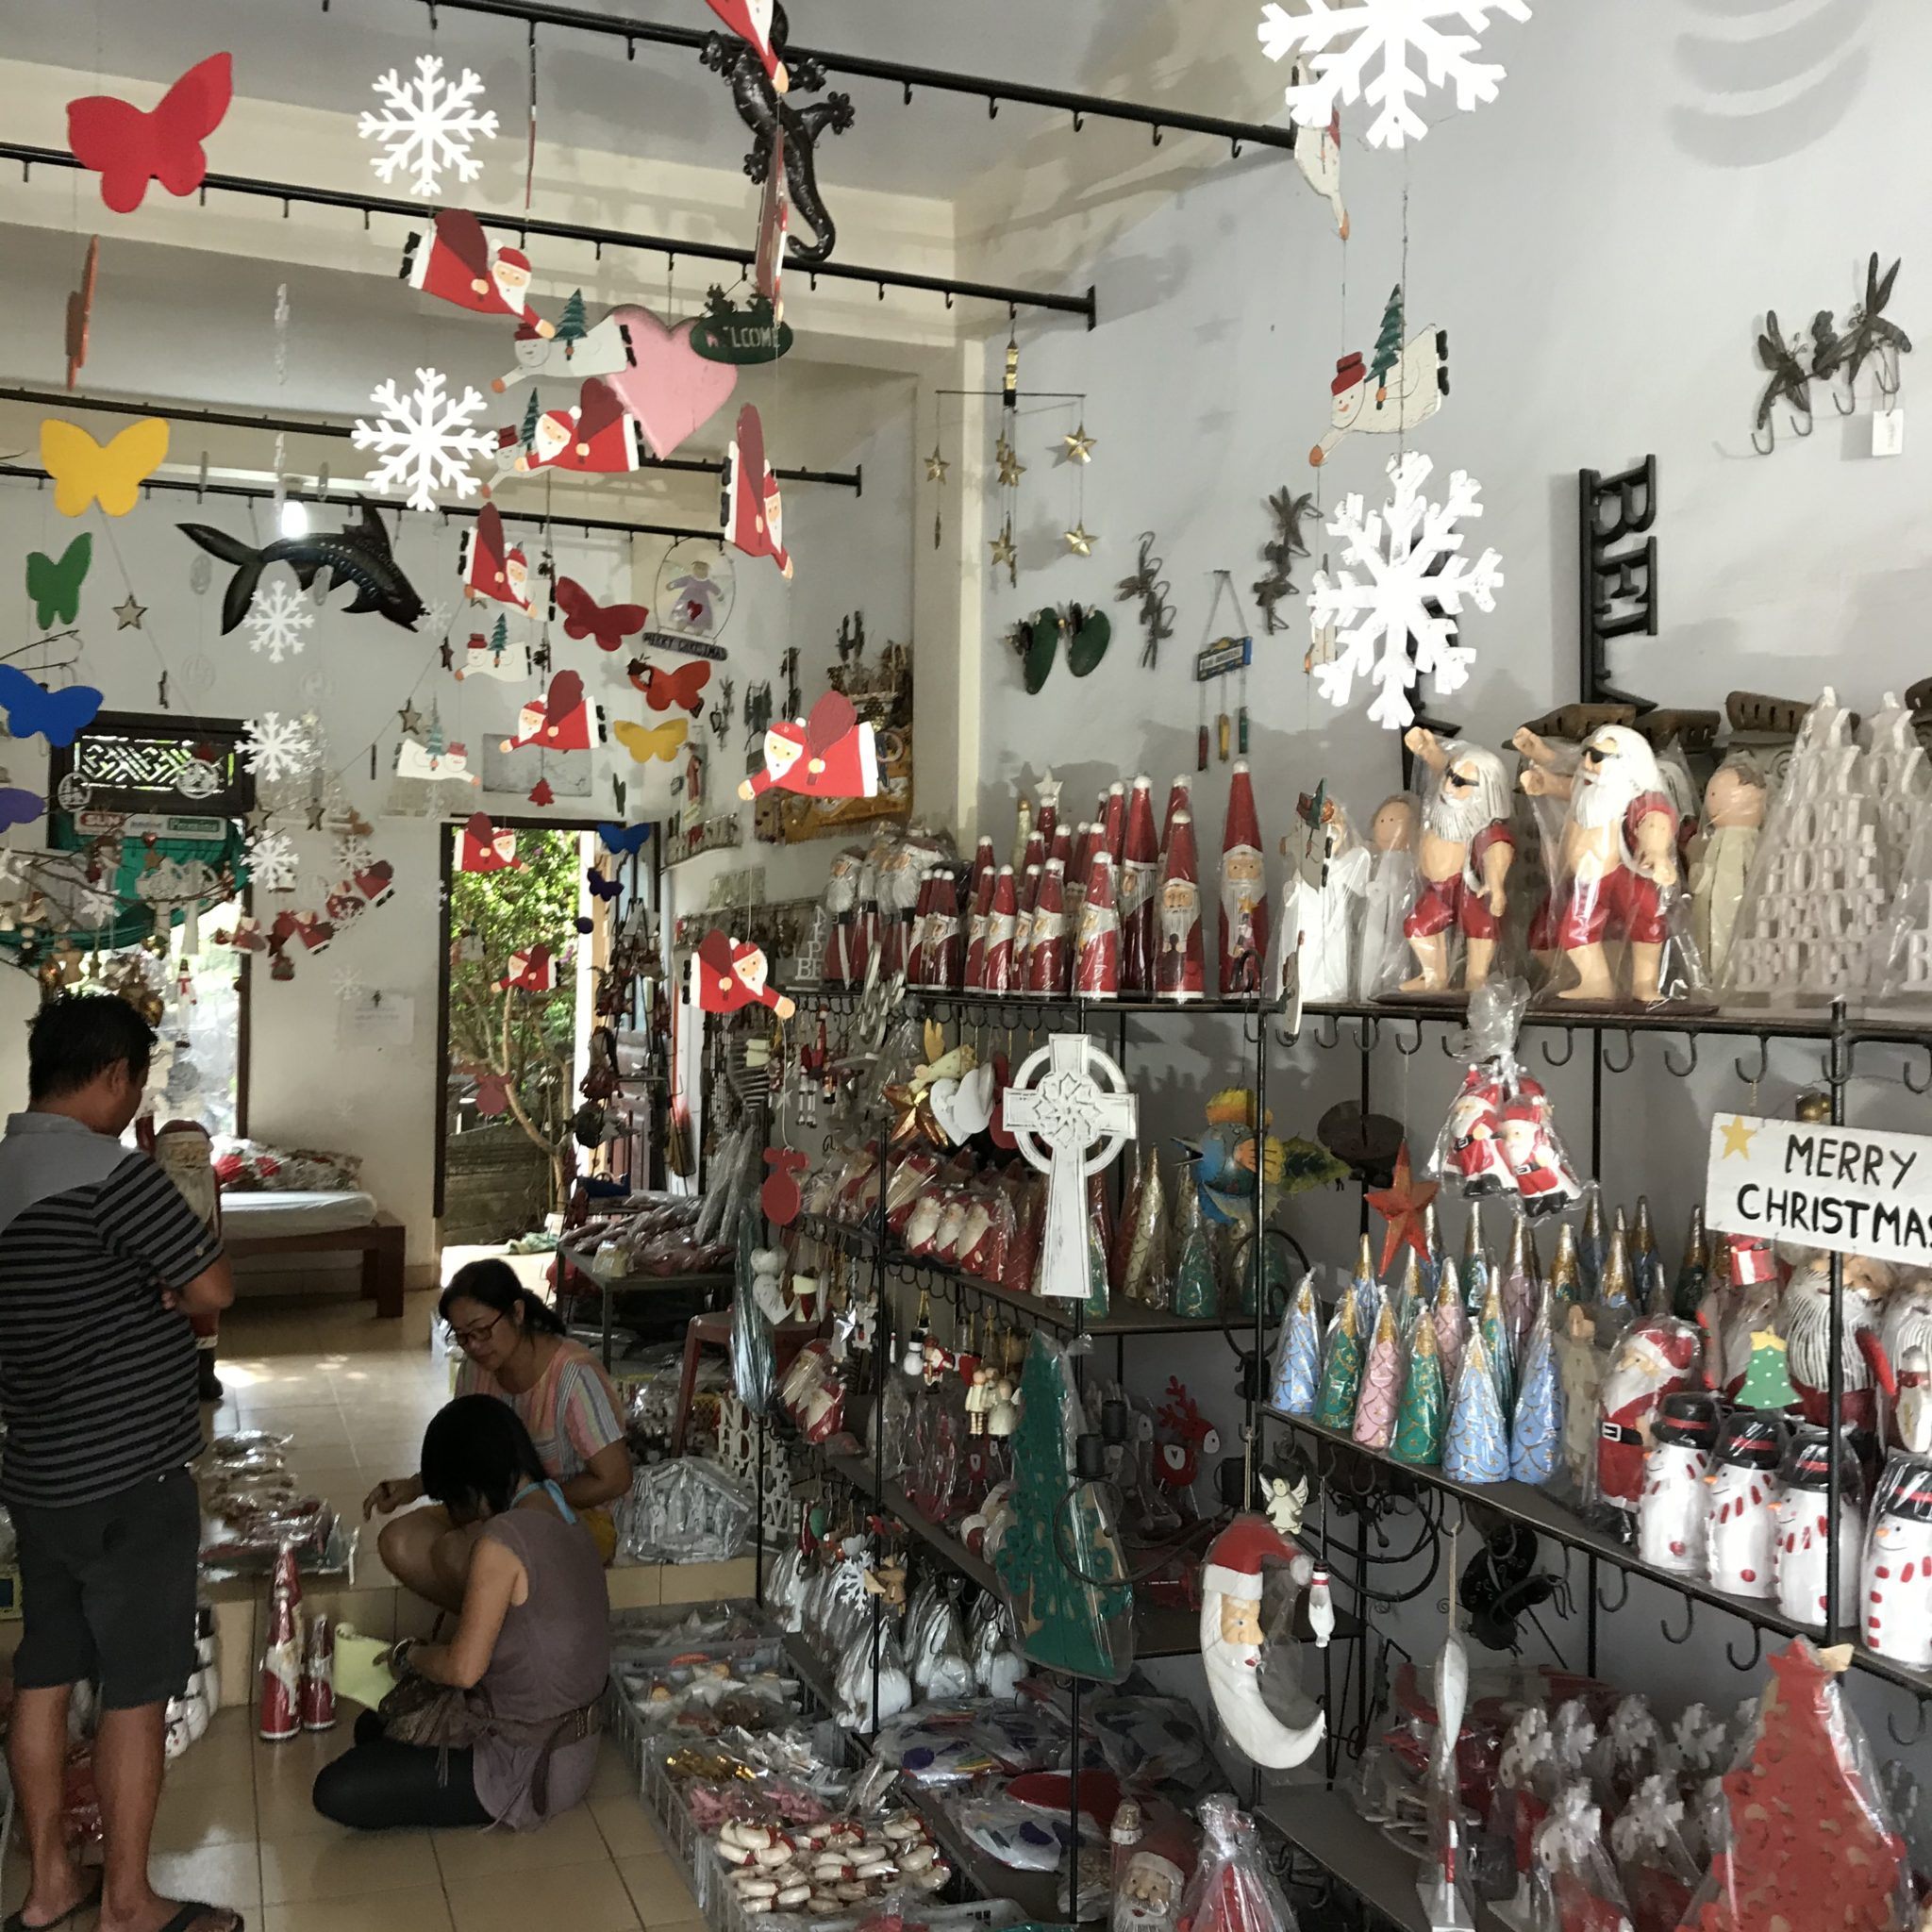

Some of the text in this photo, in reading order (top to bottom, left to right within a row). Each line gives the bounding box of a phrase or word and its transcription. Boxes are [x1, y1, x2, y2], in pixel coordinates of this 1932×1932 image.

[705, 325, 781, 348] WLCOME
[1785, 1134, 1918, 1191] MERRY
[1737, 1183, 1932, 1250] CHRISTMA
